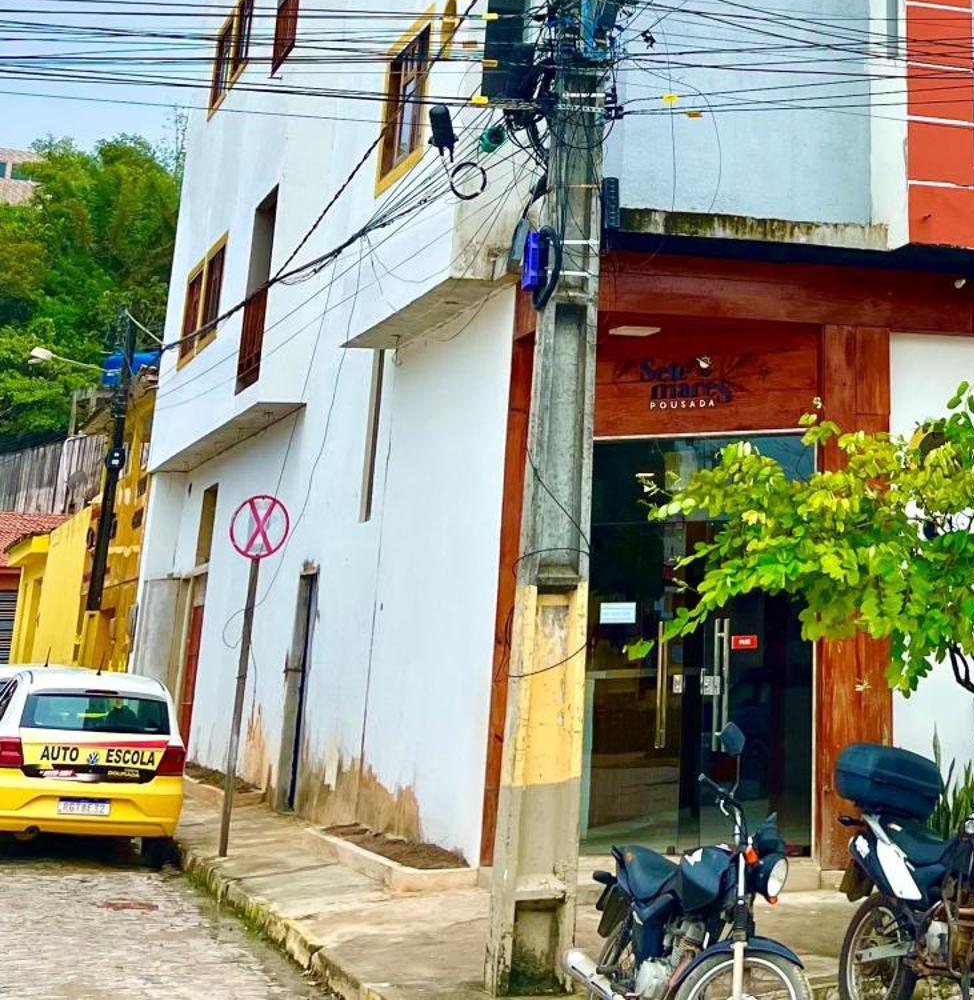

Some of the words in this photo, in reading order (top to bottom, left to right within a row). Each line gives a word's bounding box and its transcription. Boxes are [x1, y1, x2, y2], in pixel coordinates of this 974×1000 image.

[649, 398, 716, 411] POUSADA
[40, 745, 80, 762] AUTO
[105, 748, 156, 766] ESCOLA
